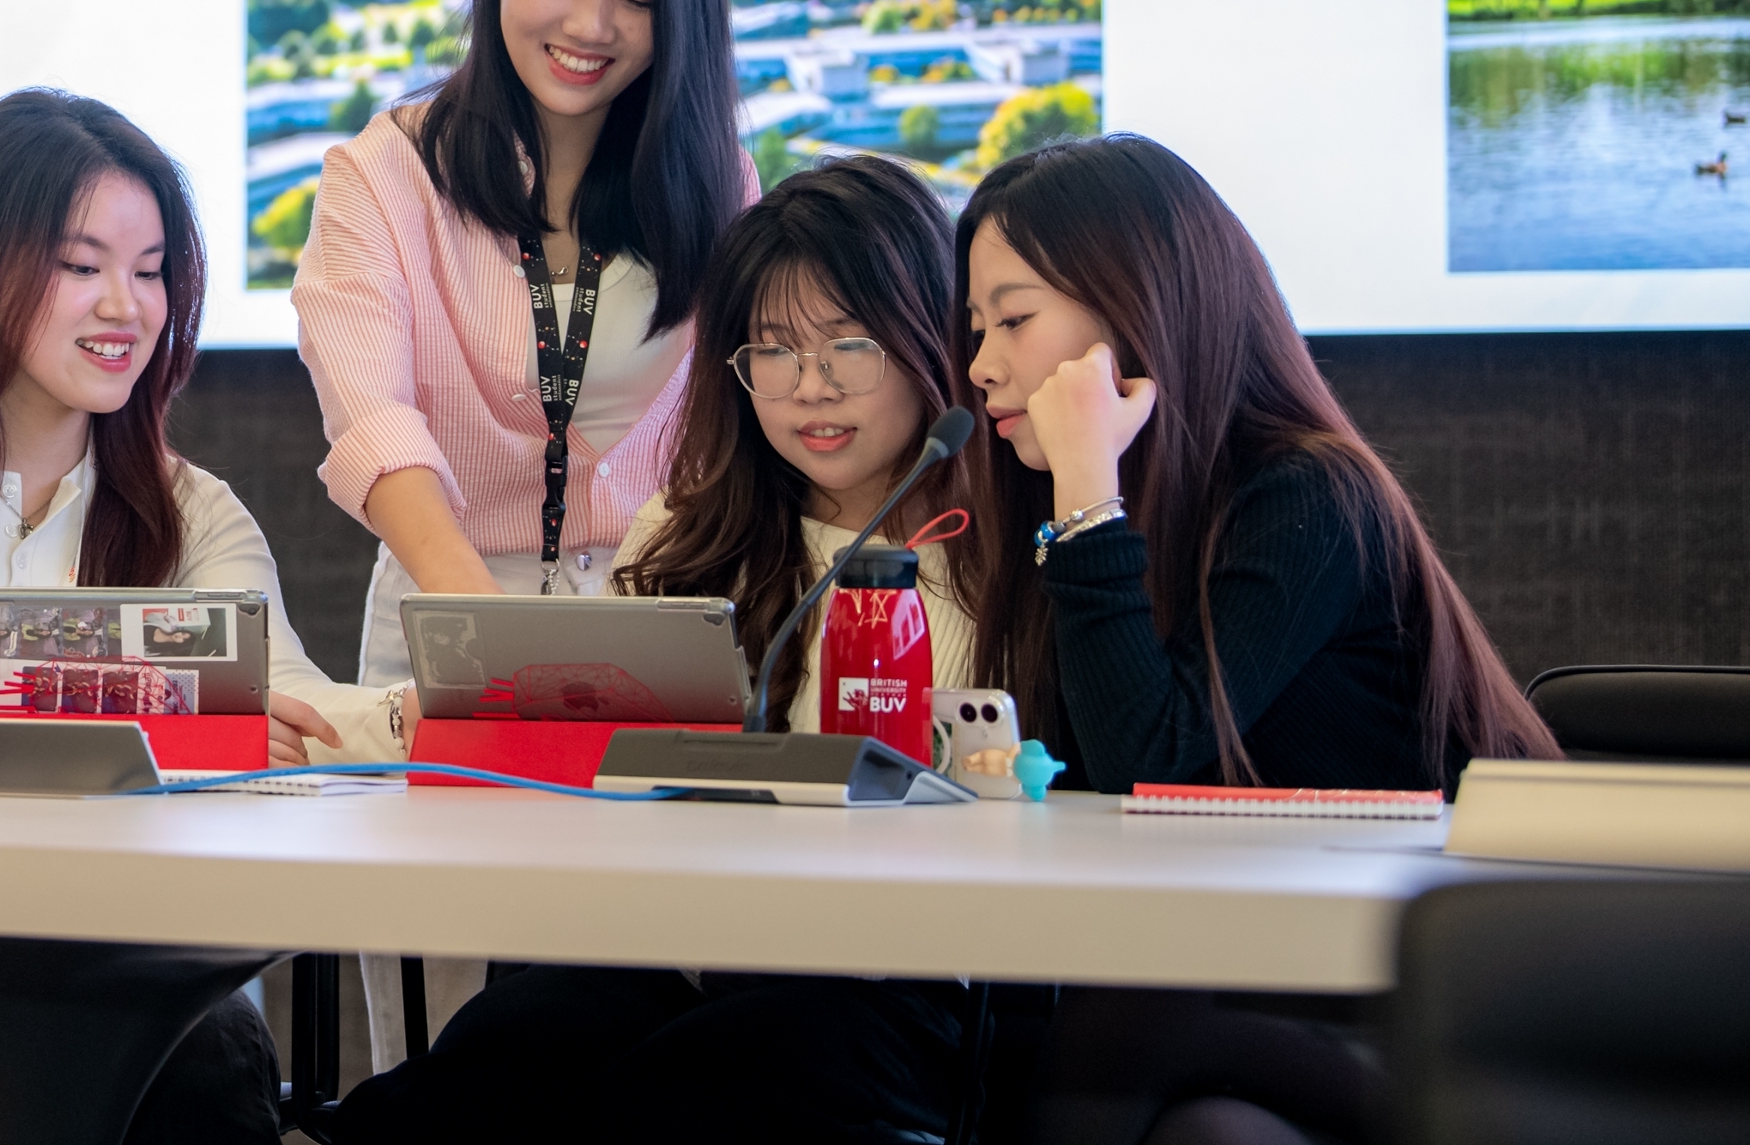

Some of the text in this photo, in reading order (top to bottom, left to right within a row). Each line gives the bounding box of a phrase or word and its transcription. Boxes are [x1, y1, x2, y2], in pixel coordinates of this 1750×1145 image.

[530, 284, 543, 309] BUV
[540, 283, 549, 308] student
[576, 287, 584, 313] student
[583, 289, 596, 315] BUV
[541, 376, 552, 402] BUV
[565, 379, 579, 406] BUV
[870, 678, 907, 688] BRITISH
[870, 697, 907, 713] BUV
